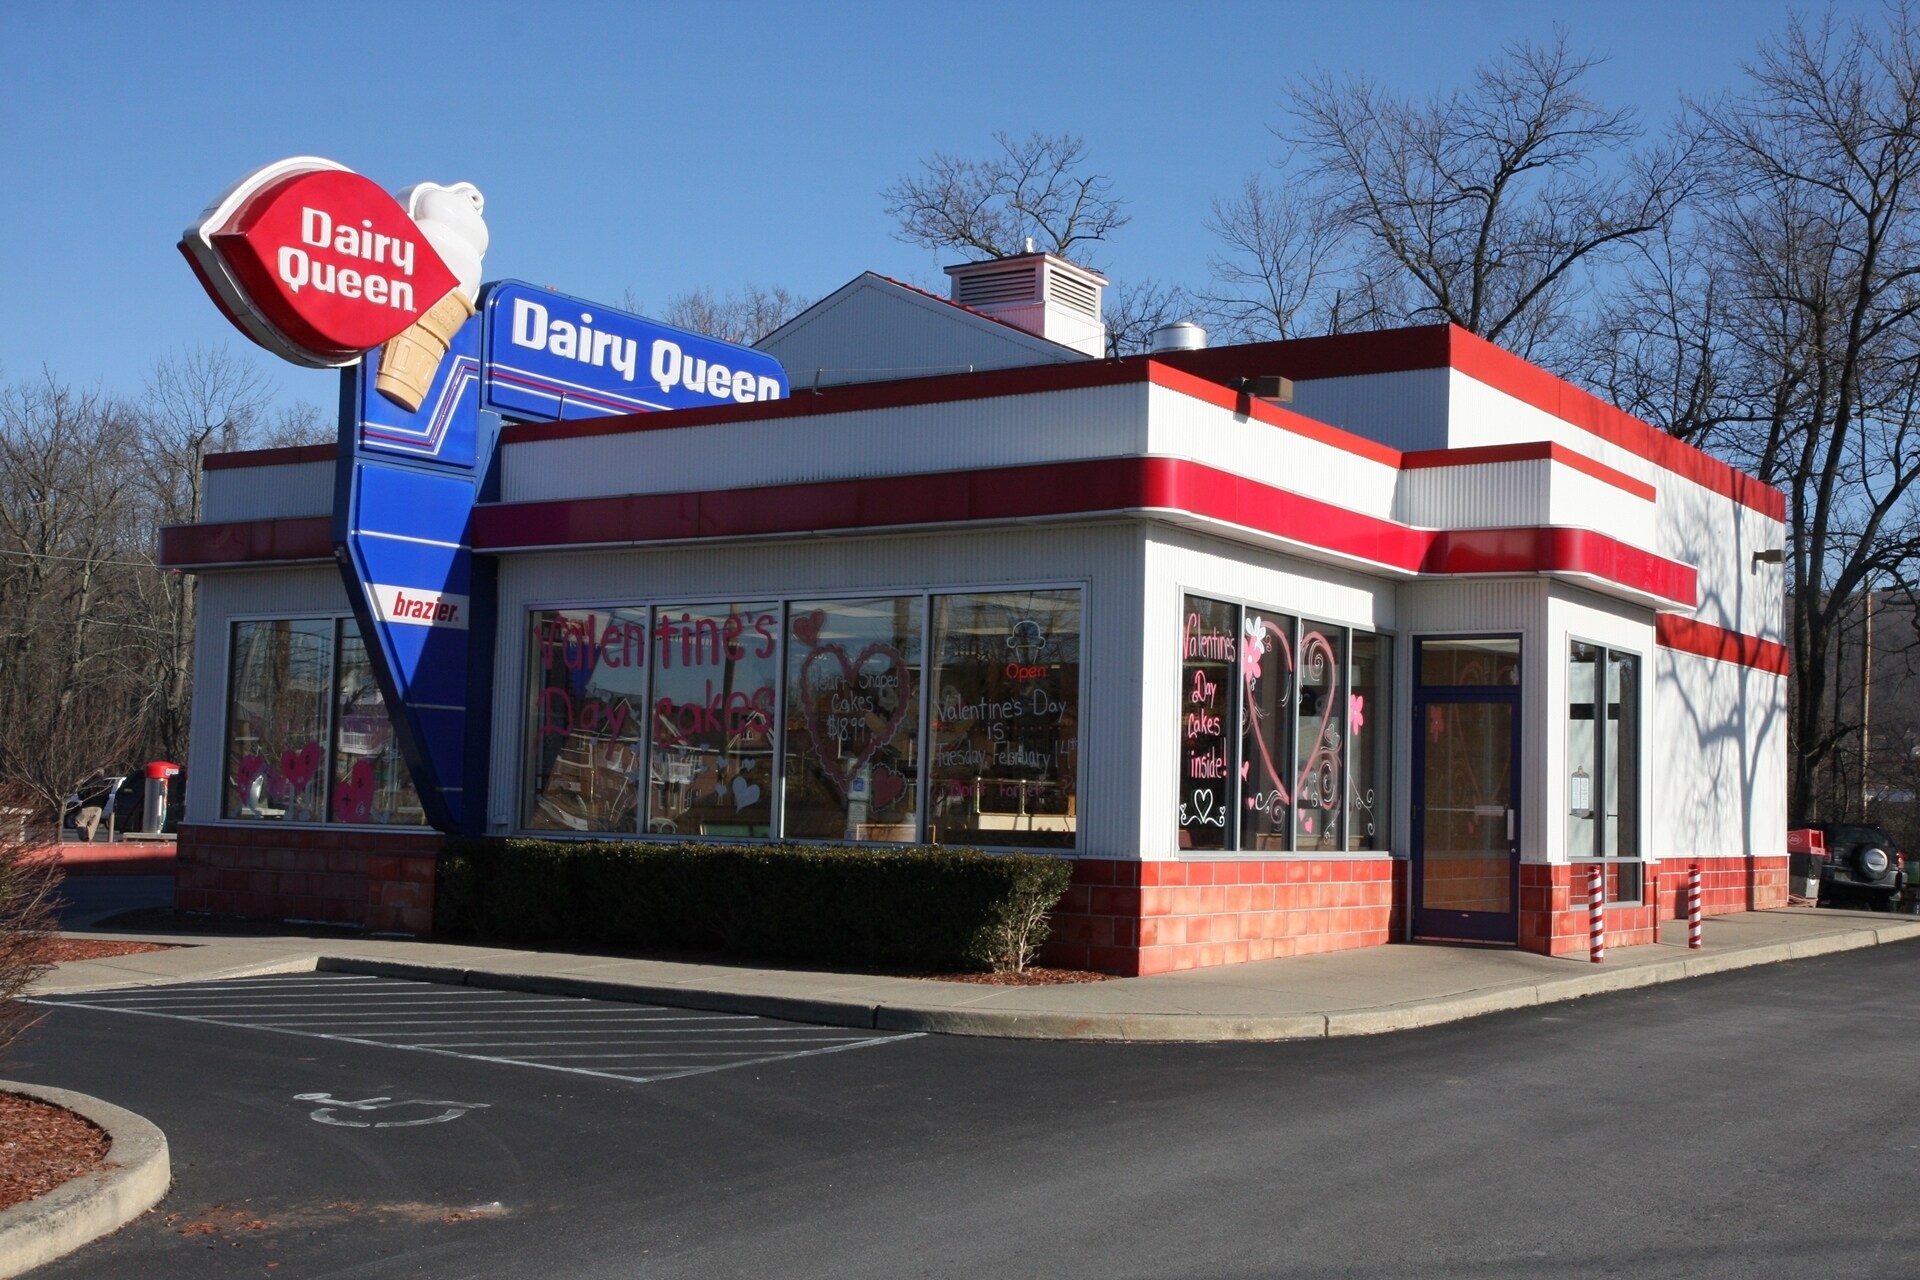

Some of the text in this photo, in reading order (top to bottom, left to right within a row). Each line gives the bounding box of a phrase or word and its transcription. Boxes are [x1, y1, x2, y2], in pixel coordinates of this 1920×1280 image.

[301, 206, 415, 276] Dairy
[277, 245, 414, 312] Queen
[512, 298, 637, 382] Dairy
[651, 339, 781, 403] Queen
[392, 591, 458, 622] brazier
[534, 611, 777, 671] Valentine's
[1183, 612, 1236, 663] Valentine's
[1006, 663, 1046, 681] Open
[1191, 669, 1216, 709] Day
[831, 689, 874, 713] Cakes
[935, 689, 1066, 723] Valentine's Day
[534, 685, 629, 761] Day
[987, 722, 1004, 741] is
[1189, 737, 1228, 779] inside!
